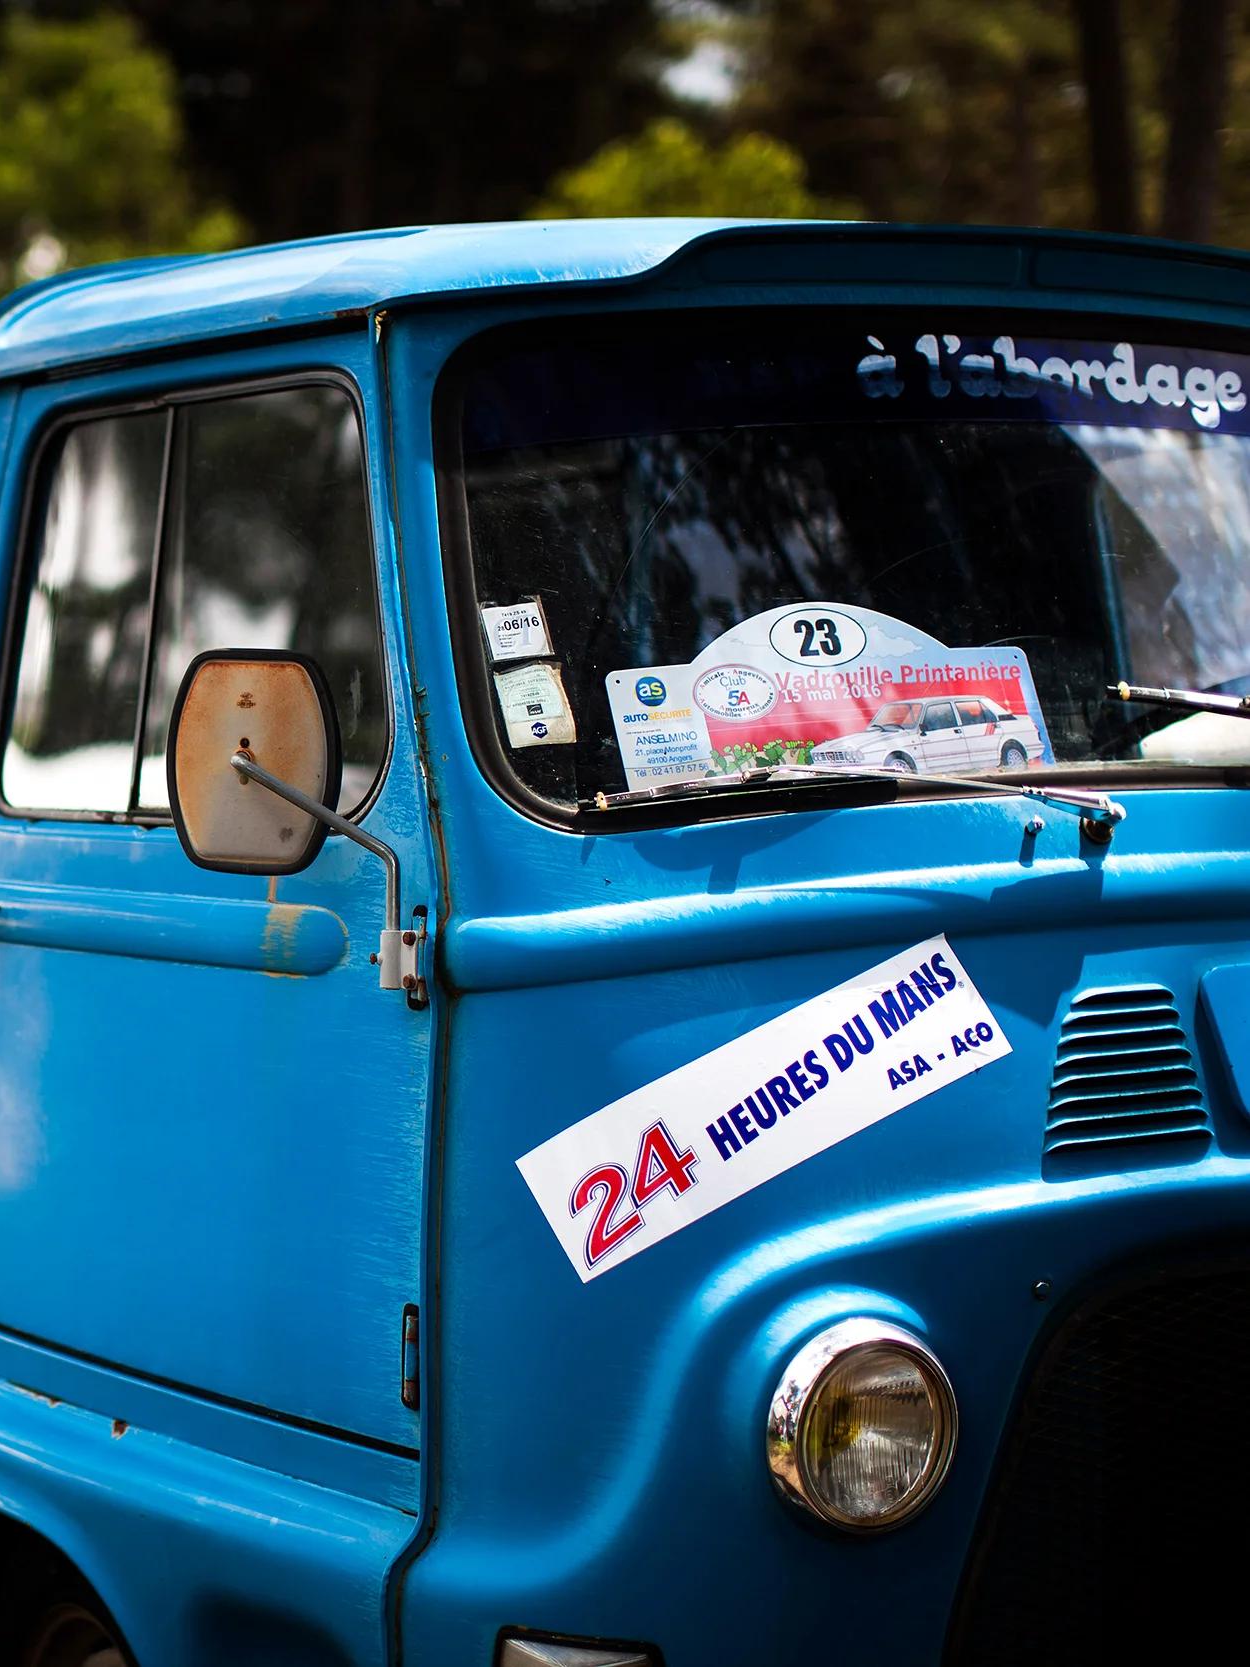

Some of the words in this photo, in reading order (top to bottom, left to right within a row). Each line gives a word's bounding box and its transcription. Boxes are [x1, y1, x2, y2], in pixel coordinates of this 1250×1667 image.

[856, 335, 905, 398] à
[915, 333, 1248, 428] l'abordage
[503, 616, 540, 631] 06/16
[793, 618, 842, 657] 23
[699, 671, 725, 690] Amicale
[733, 668, 767, 684] Angevine
[719, 675, 747, 687] Club
[775, 665, 893, 691] Vadrouille
[900, 660, 1021, 684] Printanière
[638, 681, 664, 697] as
[727, 689, 751, 706] 5A
[781, 689, 802, 703] 15
[807, 686, 837, 701] mai
[843, 684, 882, 699] 2016
[699, 698, 742, 718] Automobiles
[719, 703, 760, 713] Amoureux
[532, 726, 547, 735] AGF
[635, 731, 698, 746] ANSELMINO
[647, 756, 668, 765] 49100
[669, 754, 693, 763] Angers
[652, 767, 663, 776] 02
[664, 766, 674, 774] 41
[675, 765, 685, 773] 87
[687, 764, 697, 772] 57
[886, 1053, 932, 1091] ASA
[951, 1022, 995, 1058] ACO
[568, 1117, 701, 1271] 24
[705, 1050, 830, 1162] HEURES
[822, 1014, 876, 1073] DU
[867, 952, 957, 1040] MANS
